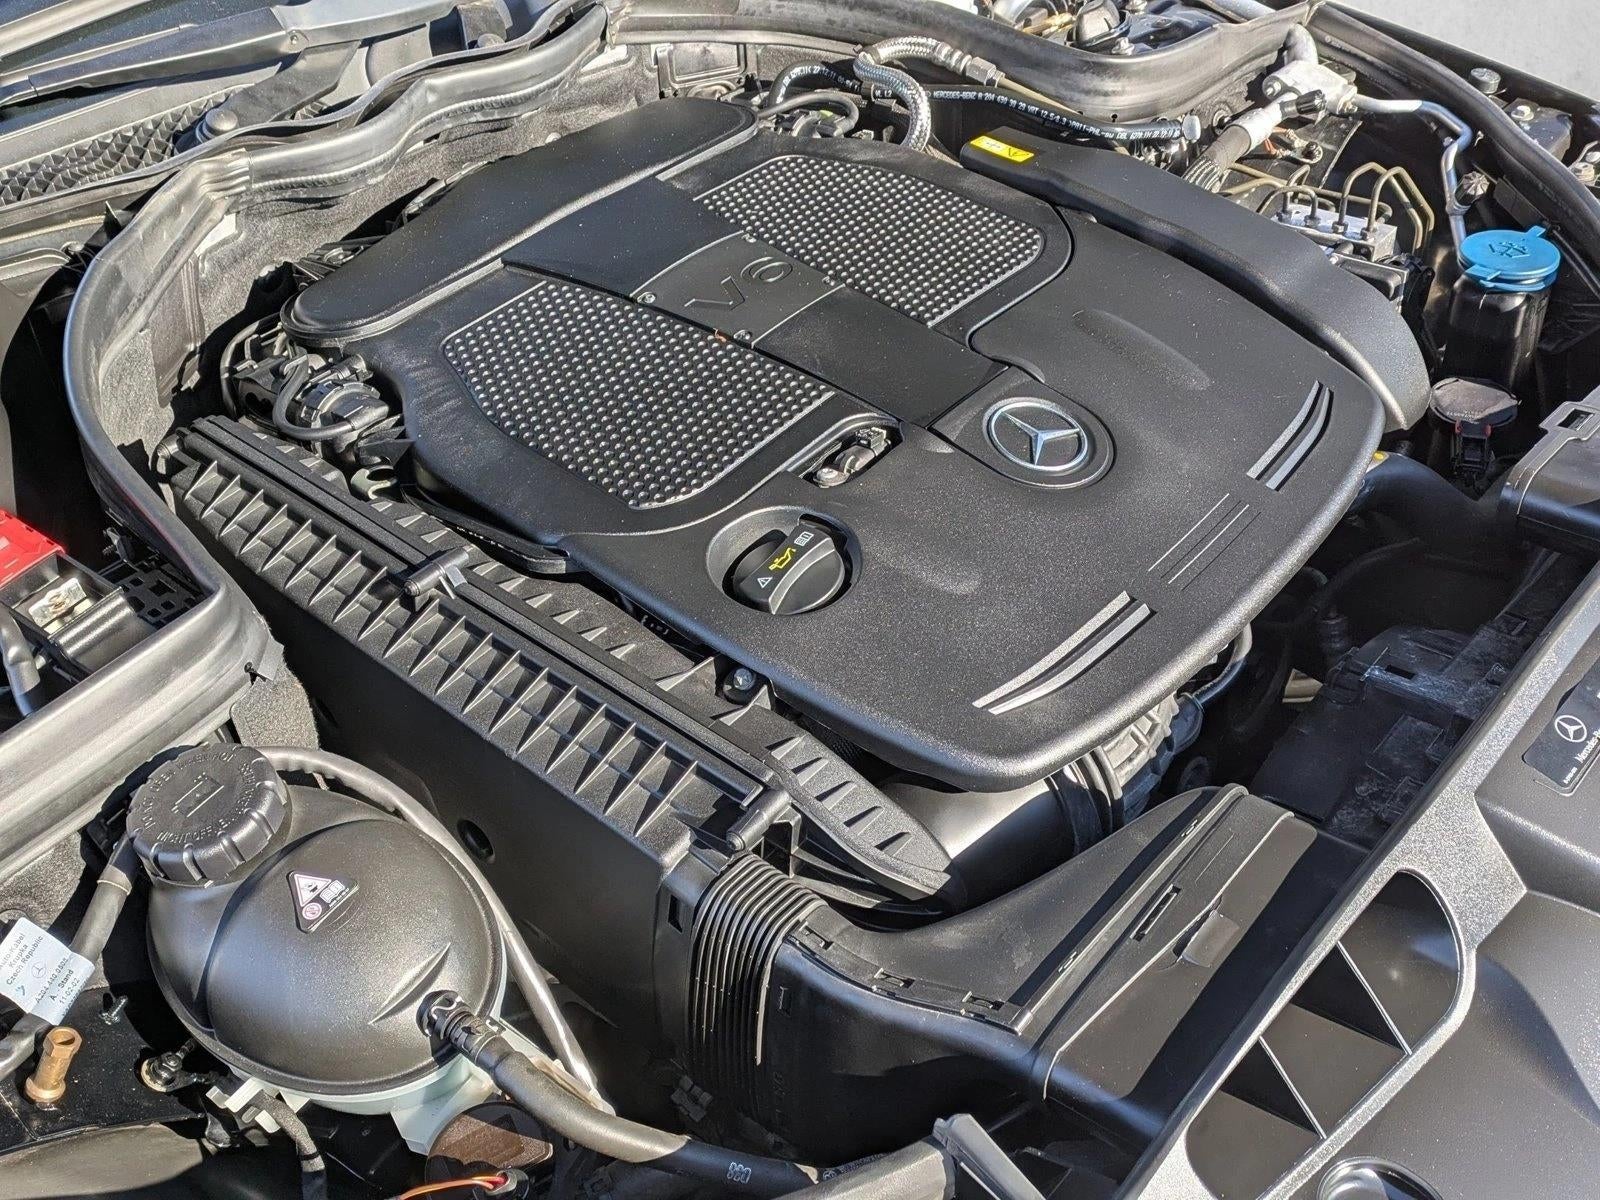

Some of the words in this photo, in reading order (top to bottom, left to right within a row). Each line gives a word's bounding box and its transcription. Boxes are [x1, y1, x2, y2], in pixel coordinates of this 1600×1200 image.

[933, 90, 977, 100] MERCEDES-BENZ
[683, 255, 794, 312] V6
[6, 965, 24, 985] Czech
[20, 935, 44, 965] Republic
[10, 943, 29, 968] Krupka
